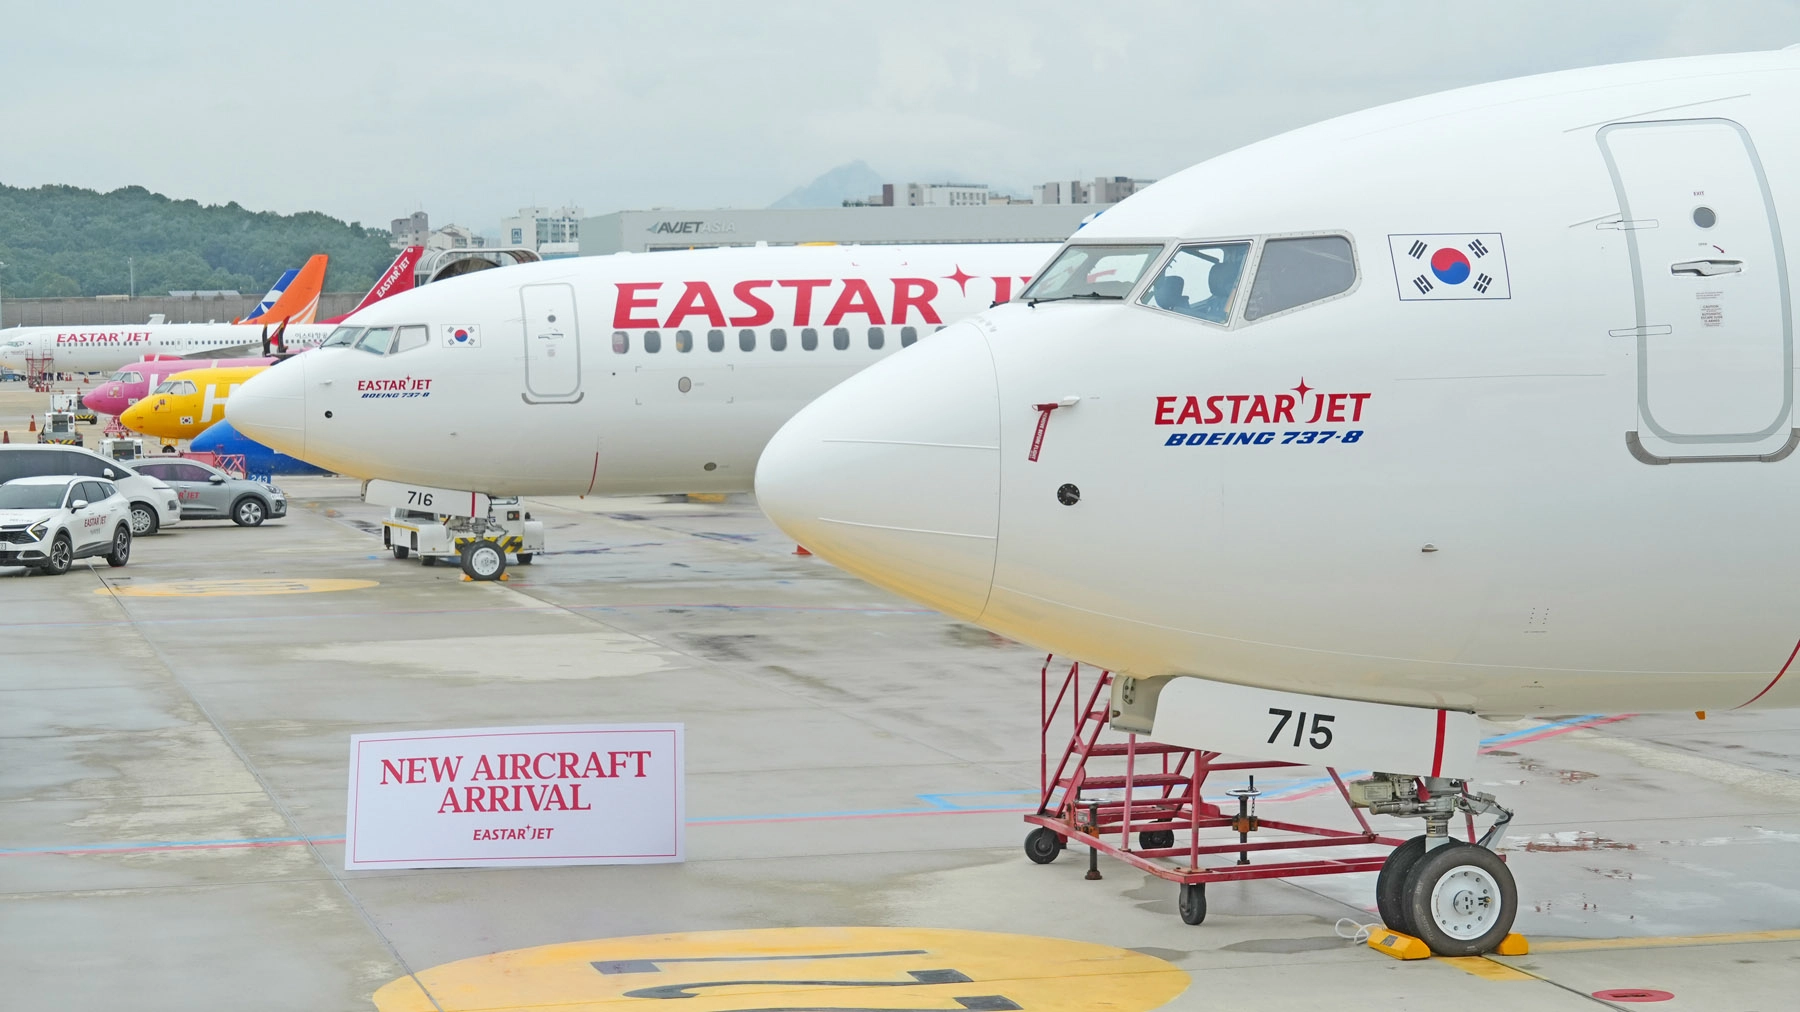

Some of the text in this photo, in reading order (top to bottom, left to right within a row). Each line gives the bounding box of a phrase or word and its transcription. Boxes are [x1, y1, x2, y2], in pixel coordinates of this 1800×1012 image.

[376, 256, 411, 298] EASTAR JET
[613, 278, 942, 329] EASTAR
[57, 332, 152, 342] EASTAR JET
[358, 379, 432, 391] EASTAR JET
[1154, 392, 1372, 426] EASTAR JET
[1164, 429, 1365, 447] BOEING 737-8
[251, 474, 268, 483] 243
[407, 491, 434, 506] 716
[84, 515, 107, 528] EASTAR JET
[1267, 708, 1336, 750] 715
[381, 751, 652, 785] NEW AIRCRAFT
[437, 783, 591, 814] ARRIVAL
[473, 827, 554, 841] EASTAR JET
